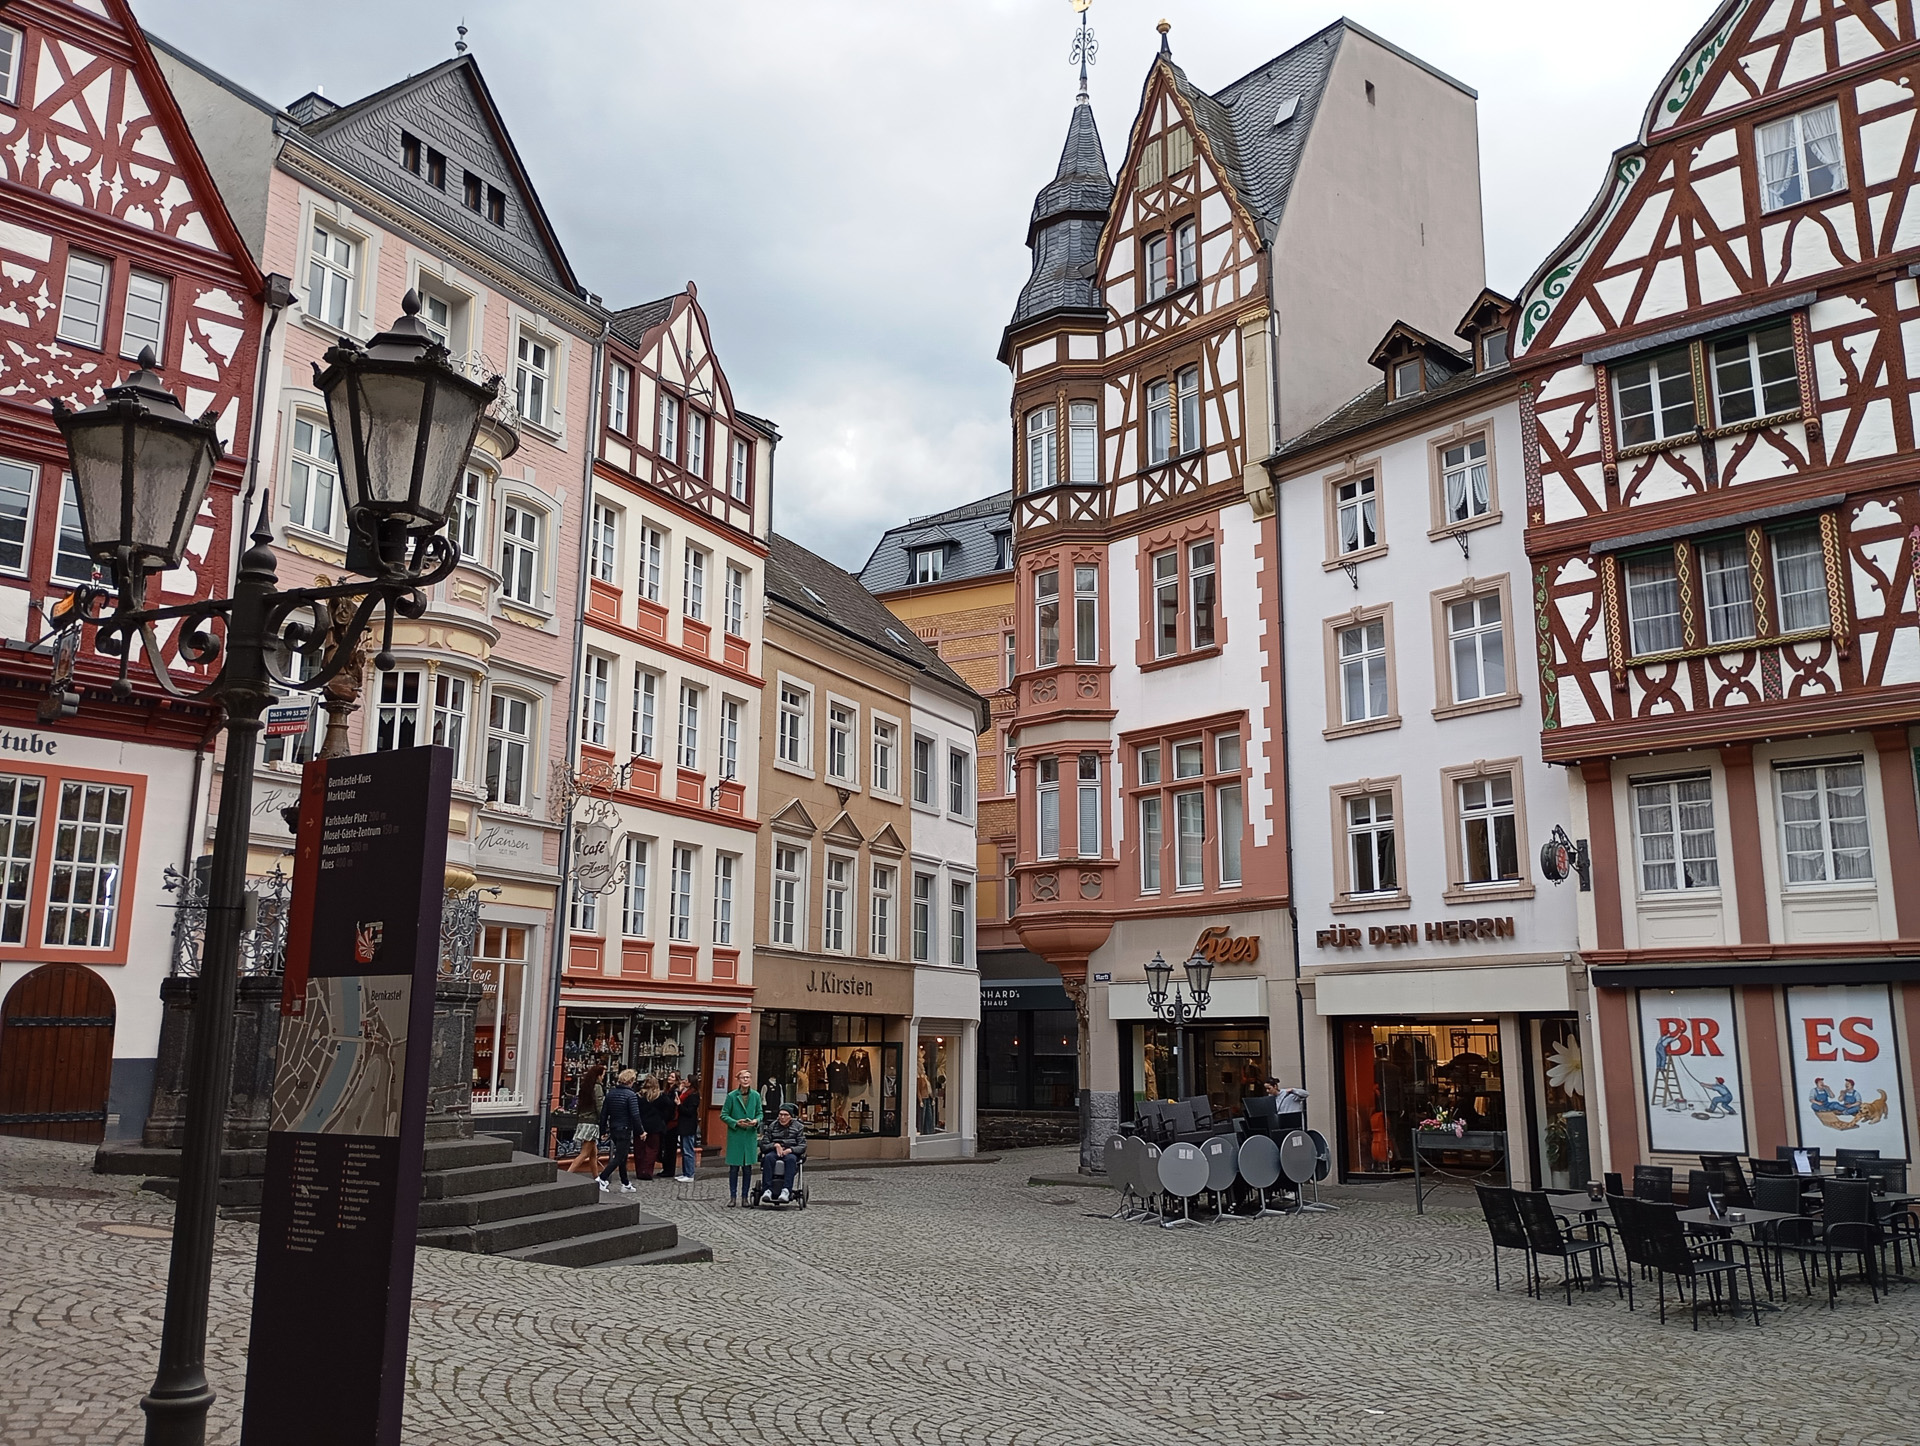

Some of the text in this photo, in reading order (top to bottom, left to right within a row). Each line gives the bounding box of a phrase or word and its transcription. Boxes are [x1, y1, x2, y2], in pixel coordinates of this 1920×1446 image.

[276, 724, 308, 732] VERKAUFEN
[0, 729, 57, 756] tube
[328, 773, 372, 788] Bernkastel-Kues
[327, 790, 356, 802] Marktplatz
[325, 814, 353, 826] Karlsbader
[354, 812, 368, 824] Platz
[324, 826, 382, 840] Mosel-Gäste-Zentrum
[478, 826, 530, 850] Hansen
[322, 843, 350, 855] Moselkino
[321, 859, 334, 870] Kues
[1316, 916, 1515, 949] FÜR DEN HERRN
[806, 970, 872, 996] J. Kirsten
[371, 990, 402, 1001] Bernkastel
[1656, 1017, 1725, 1058] BR
[1801, 1016, 1880, 1063] ES
